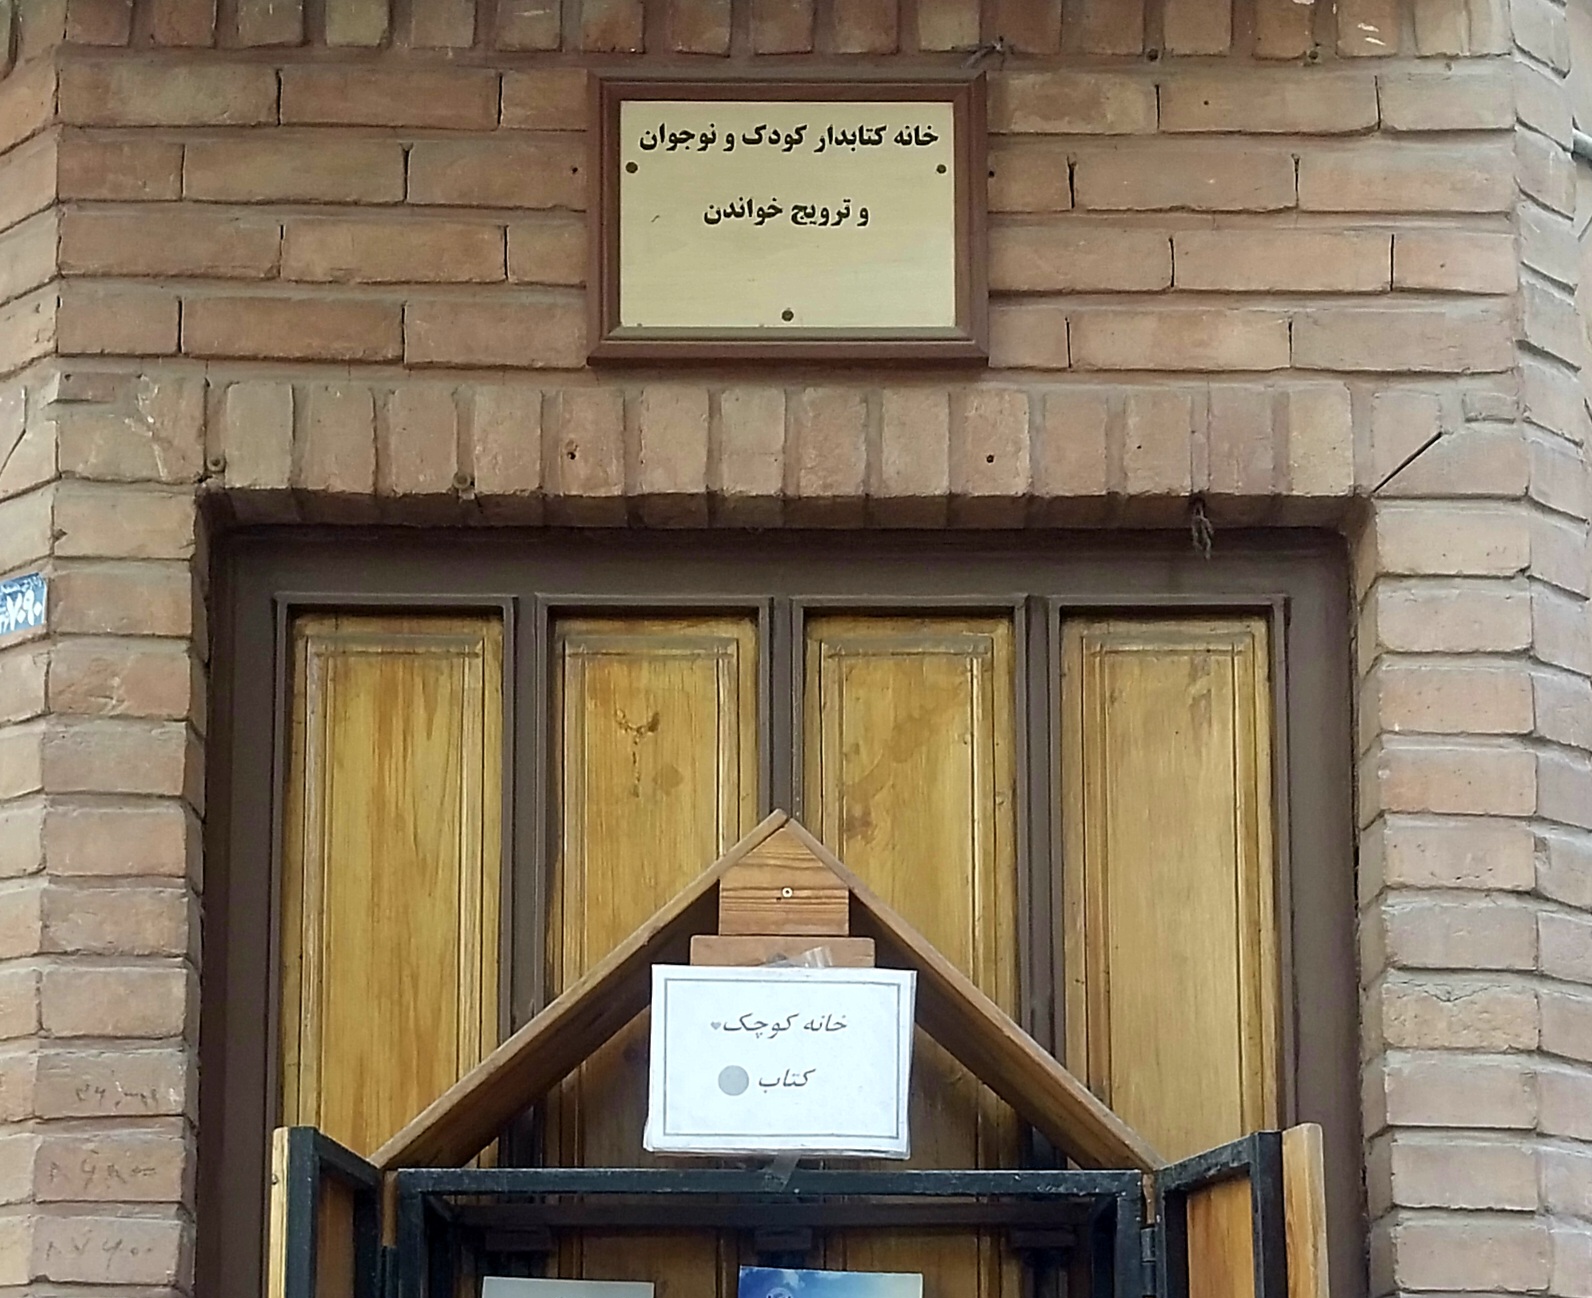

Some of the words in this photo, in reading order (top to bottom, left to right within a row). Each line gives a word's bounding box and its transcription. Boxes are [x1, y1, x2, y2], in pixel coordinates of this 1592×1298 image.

[639, 122, 717, 151] نوجوان
[723, 131, 735, 151] و
[741, 124, 807, 152] کودک
[814, 124, 887, 152] کتابدار
[893, 124, 939, 147] خانه
[703, 196, 783, 227] خواندن
[790, 199, 852, 227] ترویج
[857, 205, 869, 227] و
[723, 1012, 800, 1039] کوچک
[803, 1013, 848, 1032] خانه
[758, 1068, 816, 1094] کتاب
